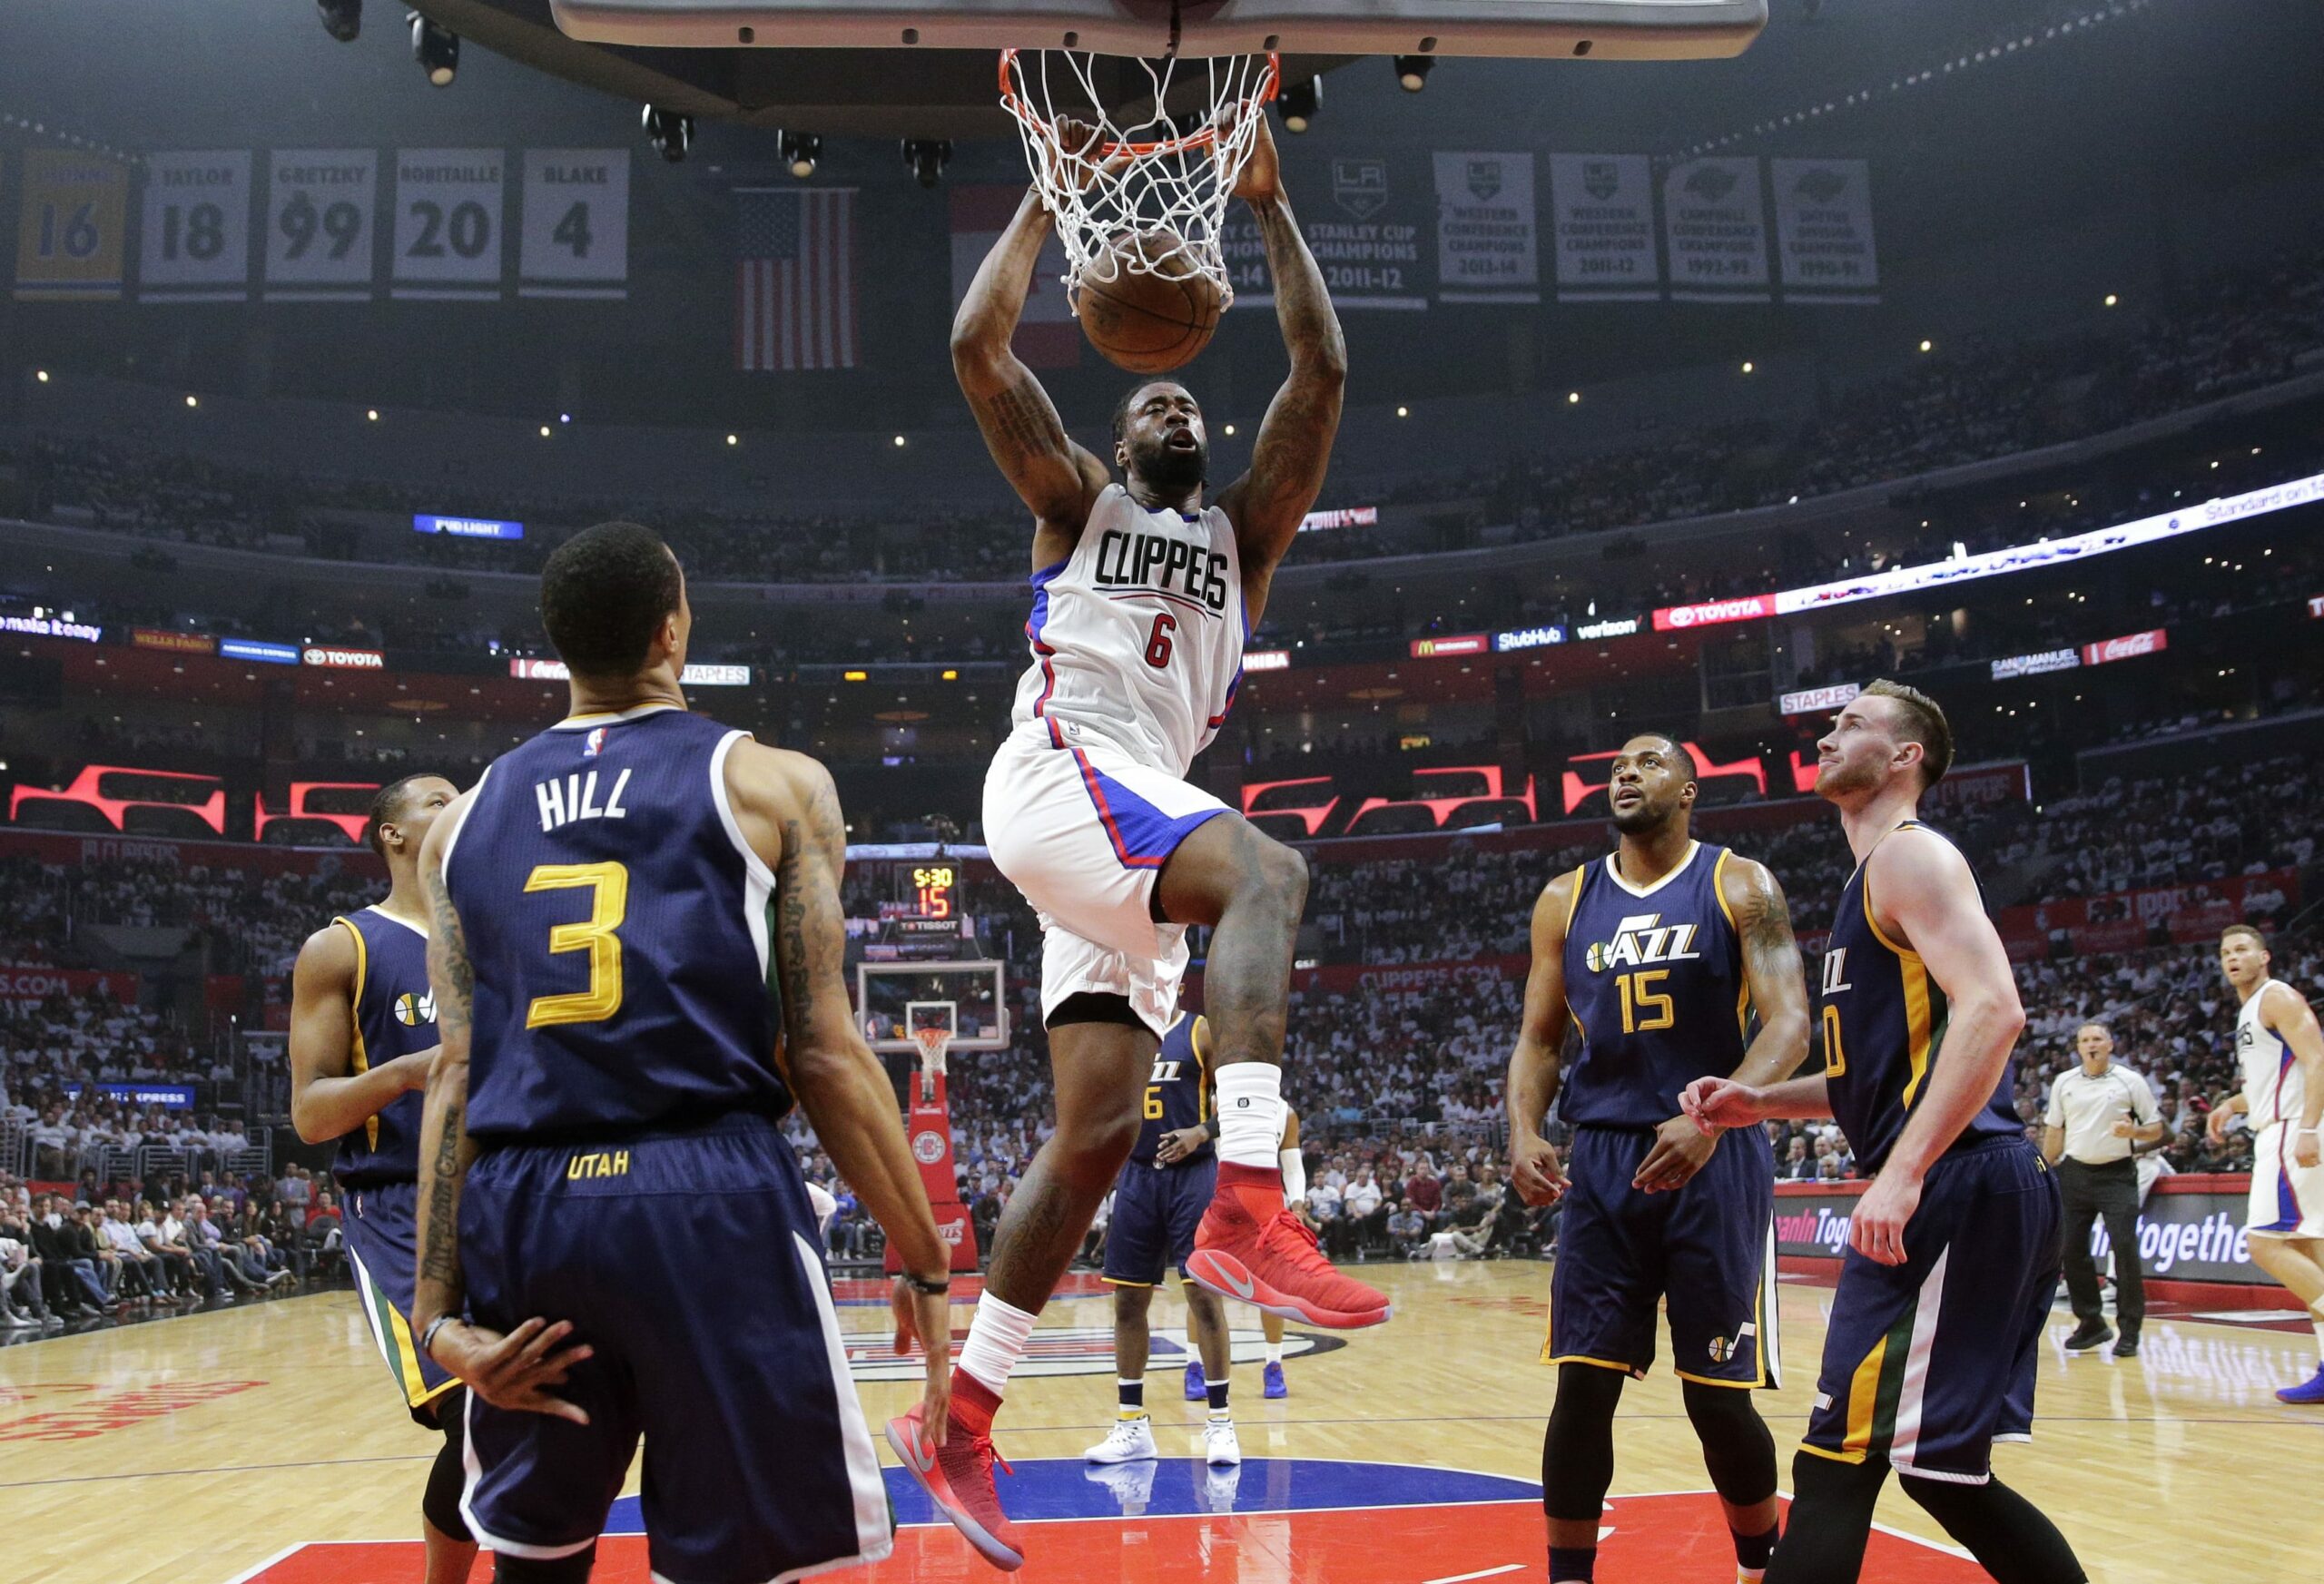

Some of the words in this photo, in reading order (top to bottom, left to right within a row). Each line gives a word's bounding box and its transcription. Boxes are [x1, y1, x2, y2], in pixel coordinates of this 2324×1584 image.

[162, 168, 233, 186] TAYLOR
[279, 165, 368, 184] GRETZKY
[400, 165, 498, 184] ROBITAILLE
[544, 166, 607, 184] BLAKE
[39, 202, 99, 258] 16
[162, 203, 224, 261] 18
[279, 200, 362, 261] 99
[406, 200, 490, 259] 20
[552, 201, 593, 259] 4
[1308, 223, 1377, 240] STANLEY
[1384, 224, 1415, 241] CUP
[1311, 242, 1417, 261] CHAMPIONS
[1326, 266, 1403, 288] 2011-12
[1695, 600, 1764, 622] TOYOTA
[1145, 613, 1177, 669] 6
[1498, 625, 1561, 650] StubHub
[1577, 619, 1637, 640] verizon
[326, 651, 383, 667] TOYOTA
[1783, 685, 1856, 713] STAPLES
[535, 769, 632, 832] HILL
[913, 868, 953, 888] 5:30
[919, 888, 950, 919] 15
[918, 920, 958, 930] TISSOT
[523, 861, 628, 1029] 3
[1615, 969, 1675, 1034] 15
[1144, 1086, 1164, 1119] 6
[567, 1150, 629, 1181] UTAH
[2135, 1212, 2251, 1273] ogethe
